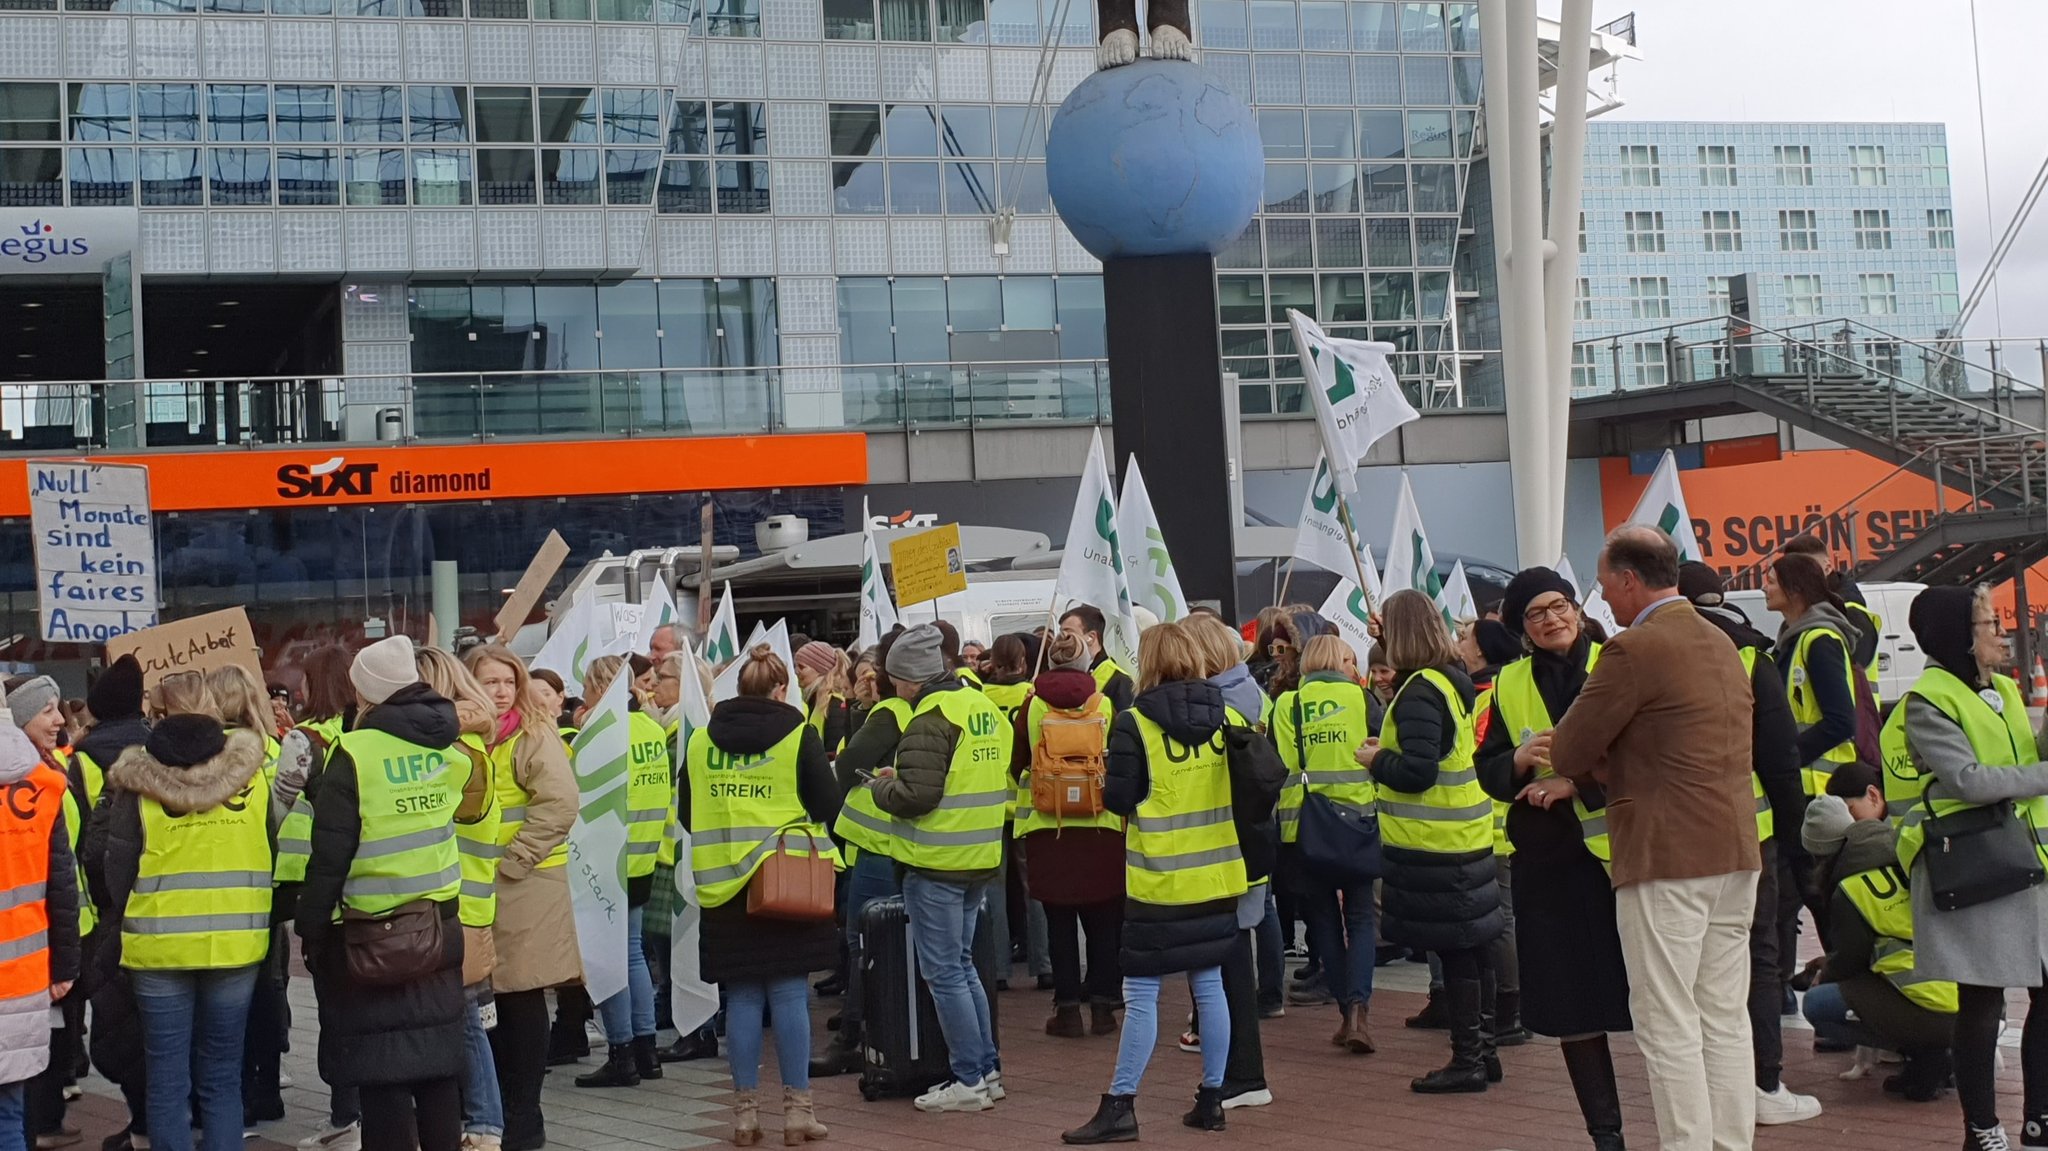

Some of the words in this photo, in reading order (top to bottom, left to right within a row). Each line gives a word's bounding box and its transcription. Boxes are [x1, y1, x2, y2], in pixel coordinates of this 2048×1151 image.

[0, 237, 88, 263] egus
[389, 468, 491, 494] diamond
[59, 499, 149, 526] Monate
[47, 523, 112, 548] sind
[81, 550, 145, 575] kein
[48, 570, 145, 602] faires
[631, 740, 666, 765] UFO
[395, 792, 448, 814] STREIK!
[710, 783, 772, 799] STREIK!
